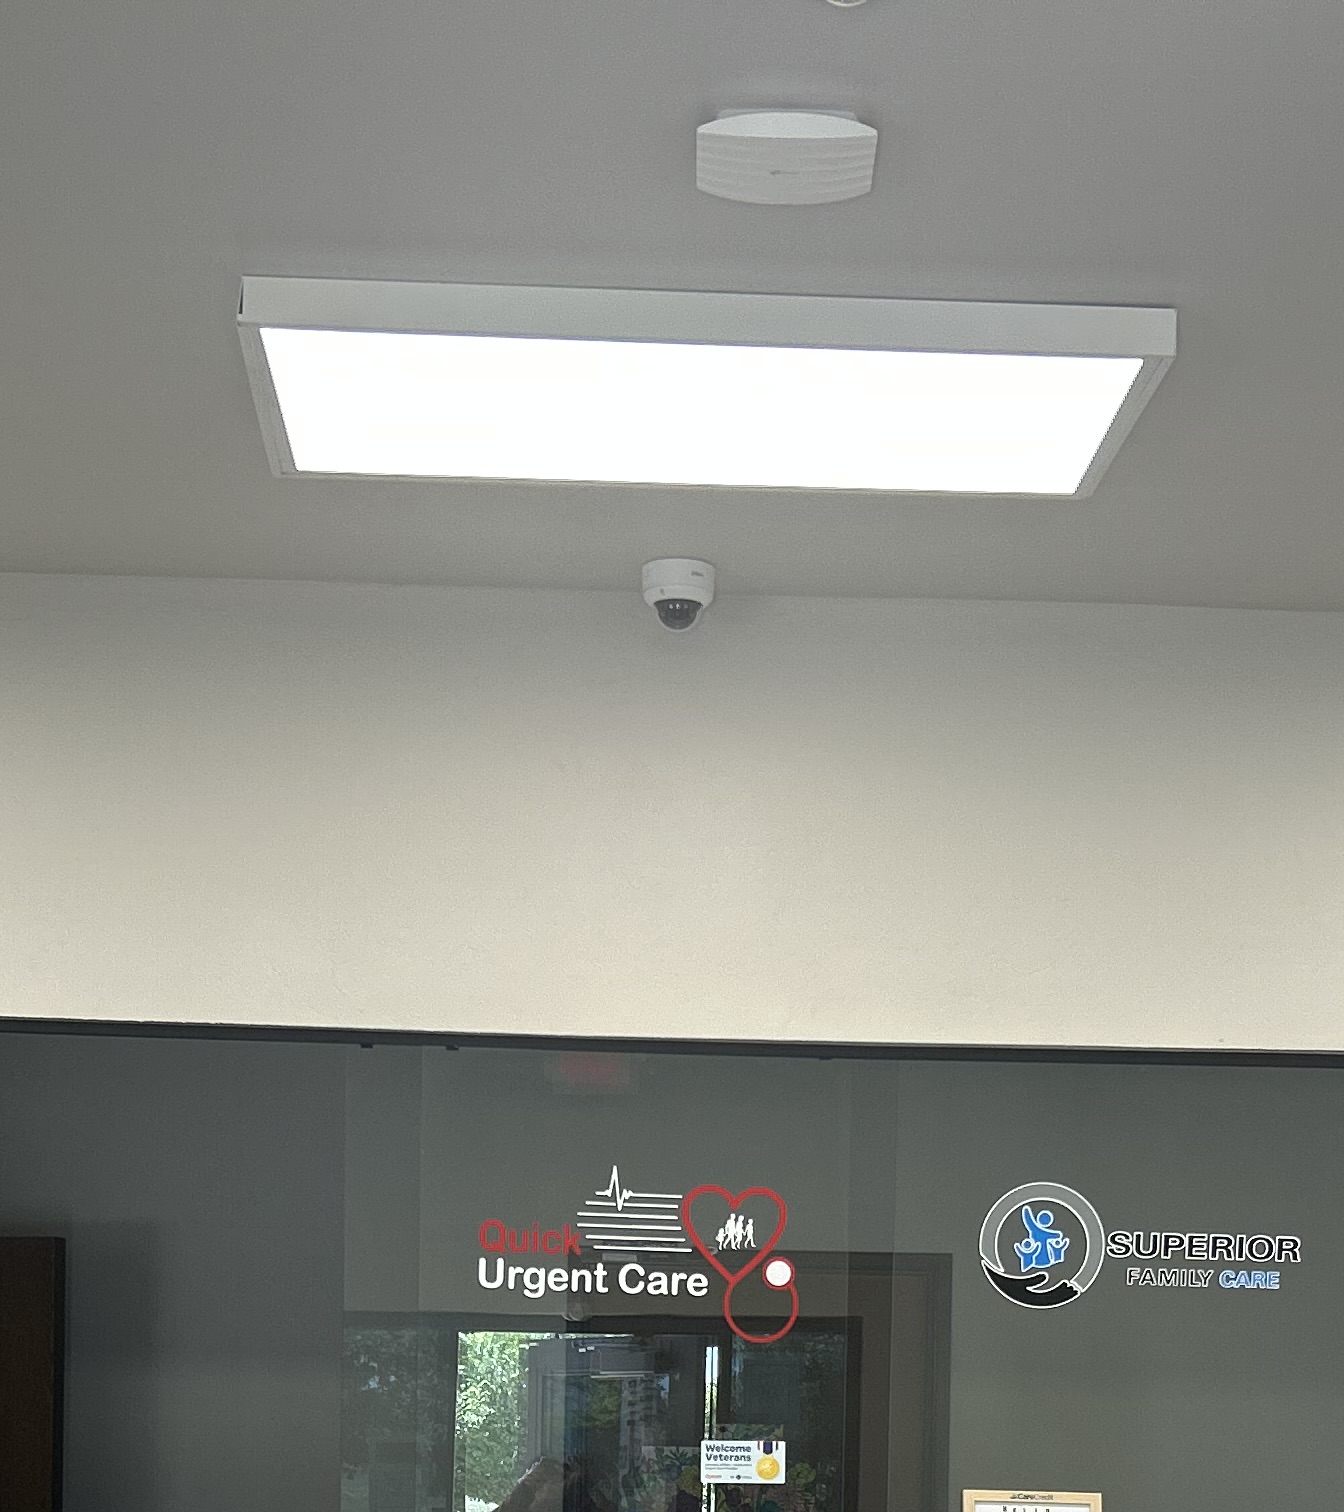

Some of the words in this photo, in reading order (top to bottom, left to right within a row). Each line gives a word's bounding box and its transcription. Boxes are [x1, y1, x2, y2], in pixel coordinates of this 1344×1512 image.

[478, 1219, 582, 1255] Quick
[1106, 1230, 1301, 1263] SUPERIOR
[478, 1257, 609, 1299] Urgent
[618, 1263, 709, 1297] Care
[1126, 1267, 1214, 1287] FAMILY
[1219, 1270, 1280, 1290] CARE
[705, 1444, 751, 1453] Welcome
[705, 1453, 751, 1461] Veterans
